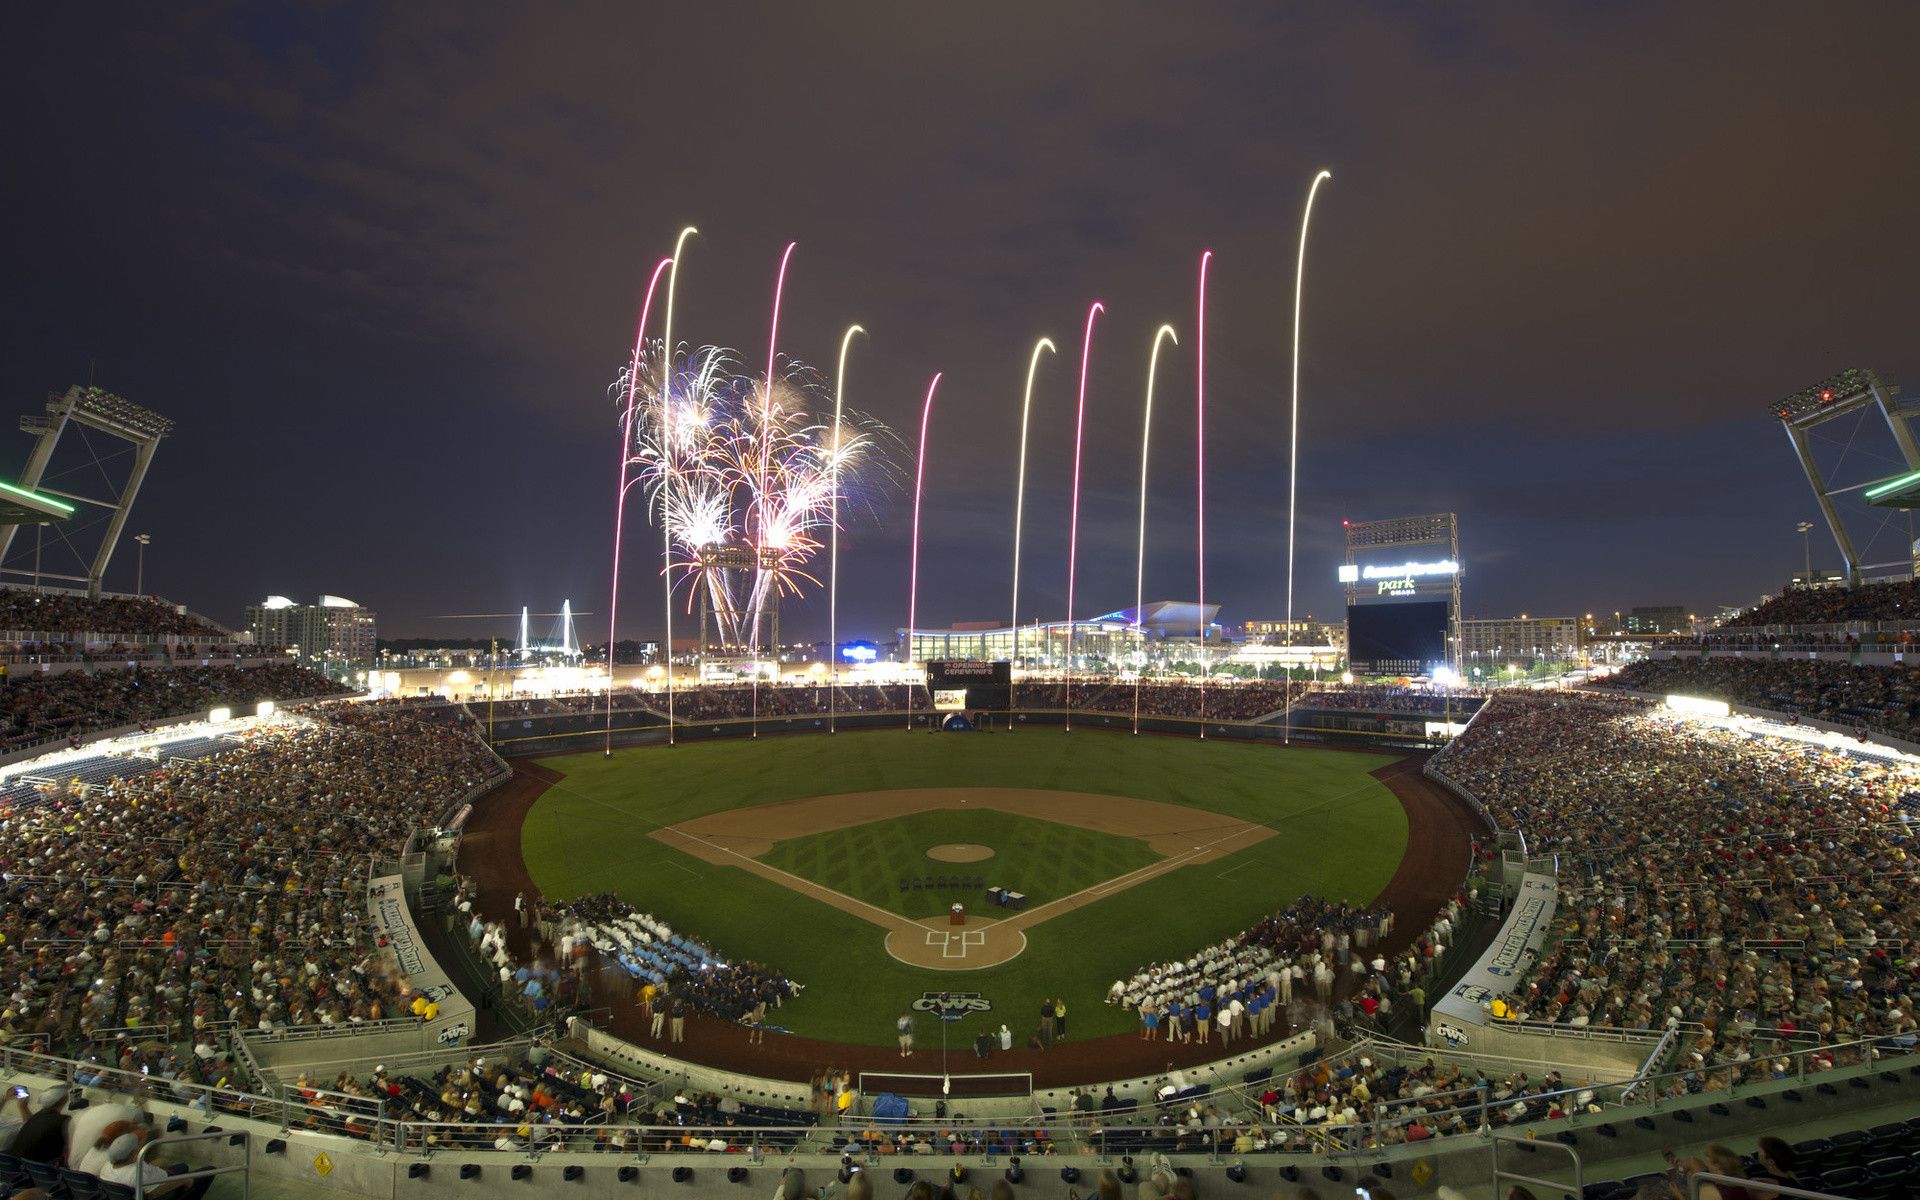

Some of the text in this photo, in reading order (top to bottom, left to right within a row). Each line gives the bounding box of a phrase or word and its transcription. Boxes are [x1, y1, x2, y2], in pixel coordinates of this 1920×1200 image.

[1378, 576, 1414, 595] park
[911, 998, 992, 1011] CWS
[437, 1025, 469, 1044] CWS
[1436, 1026, 1470, 1045] CWS
